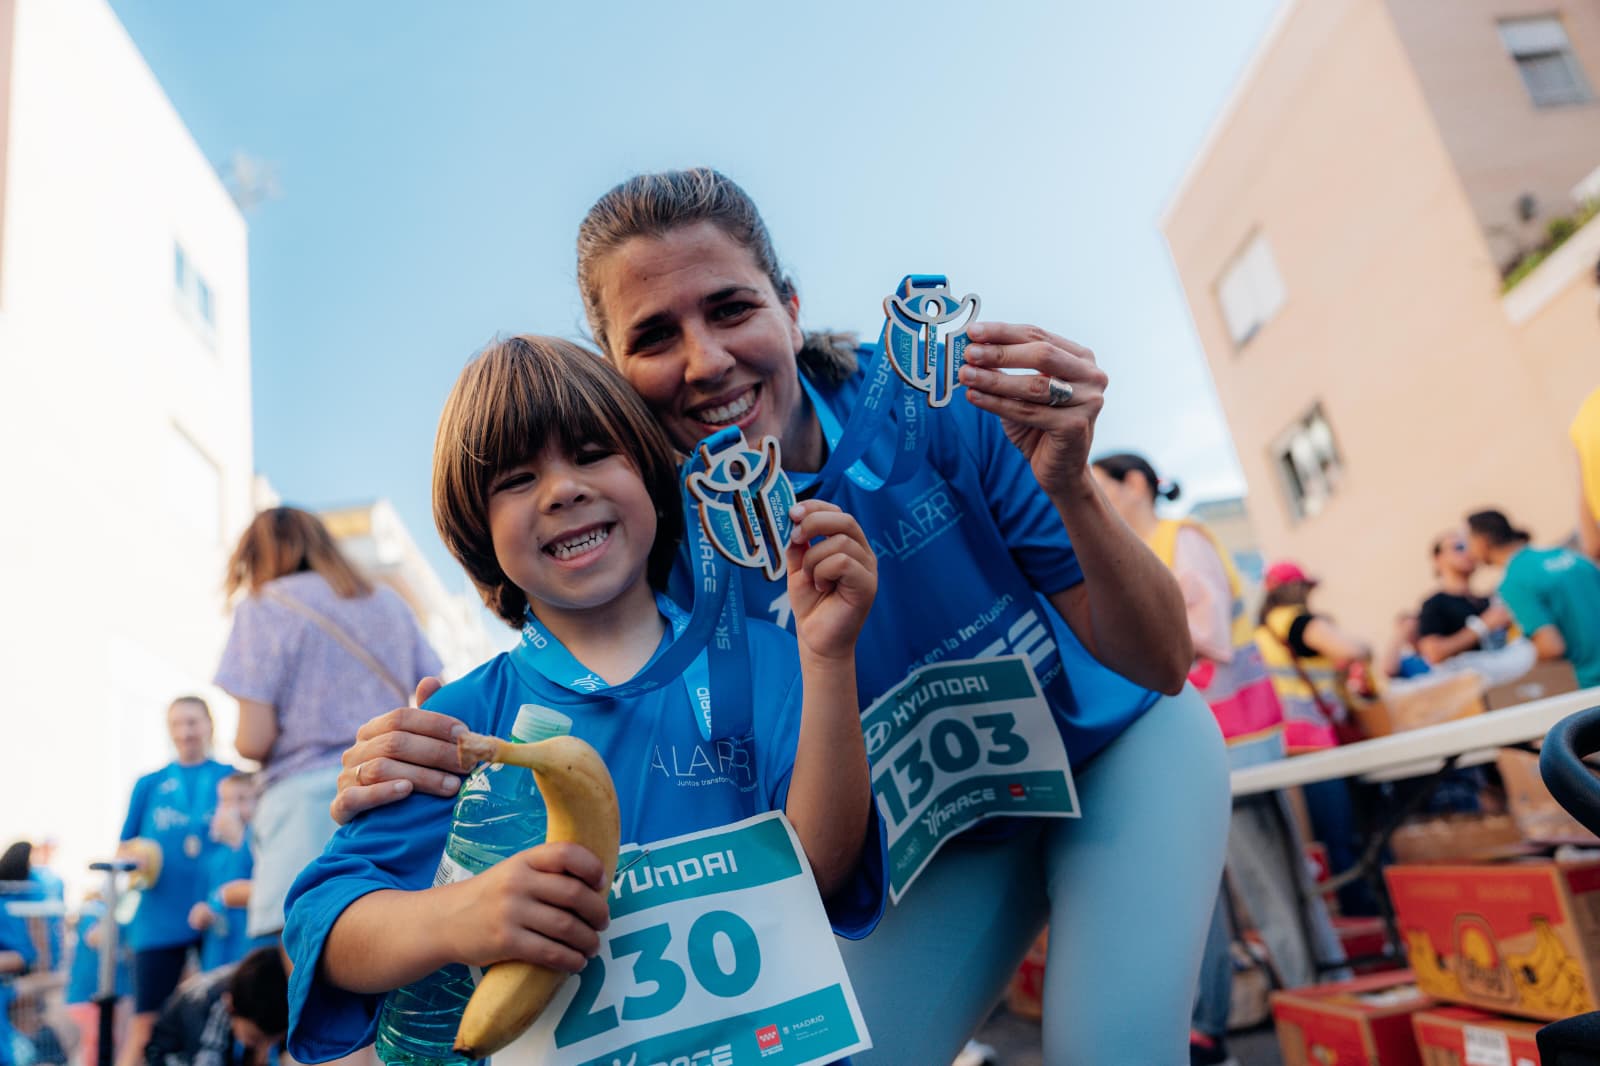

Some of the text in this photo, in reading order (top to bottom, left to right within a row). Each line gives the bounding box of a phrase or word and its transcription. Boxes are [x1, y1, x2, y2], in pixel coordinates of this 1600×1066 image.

[864, 353, 892, 411] RACE
[769, 496, 785, 531] MADRID
[942, 638, 960, 651] la
[893, 675, 989, 728] HYUNDAI
[871, 712, 1030, 830] 1303
[610, 850, 739, 900] YUNDAI
[554, 910, 761, 1050] 230
[792, 1014, 825, 1031] MADRID
